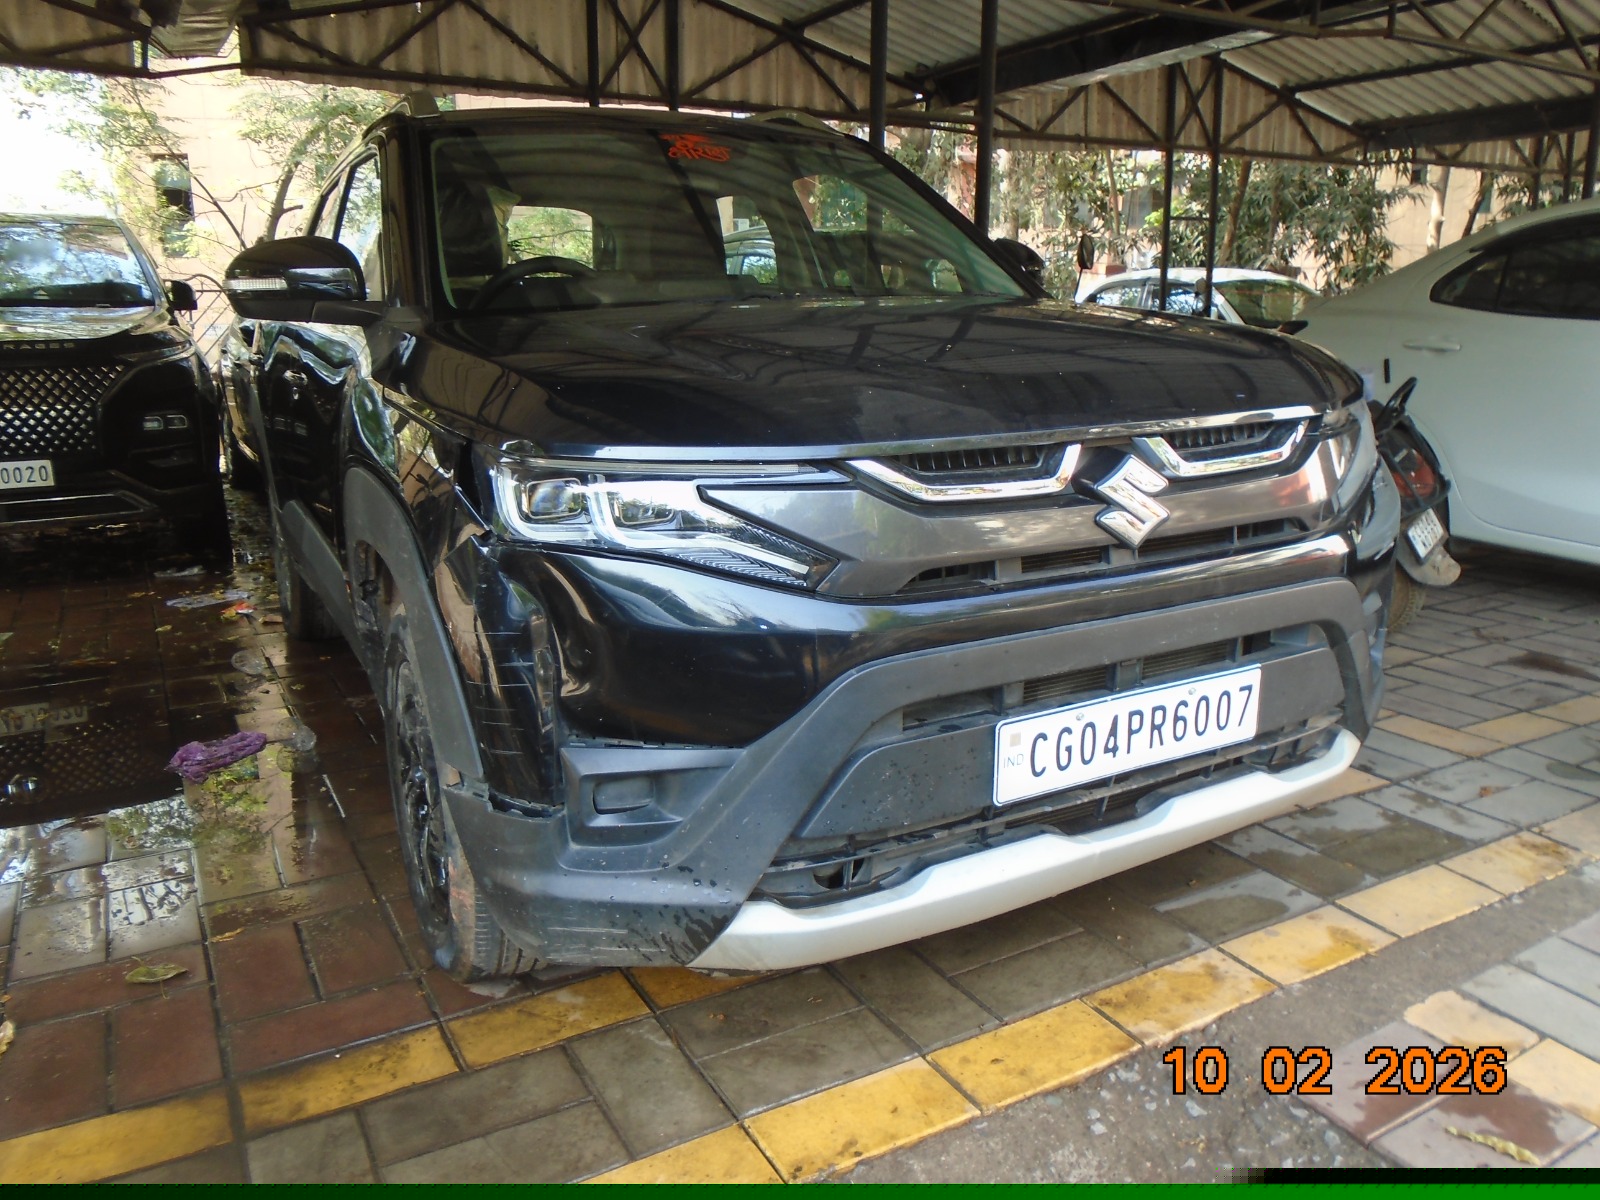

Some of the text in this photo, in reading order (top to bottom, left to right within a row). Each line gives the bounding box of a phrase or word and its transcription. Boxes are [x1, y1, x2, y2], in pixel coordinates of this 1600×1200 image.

[0, 465, 48, 484] 0020
[1030, 684, 1254, 778] CG04PR6007
[1003, 753, 1025, 769] IND
